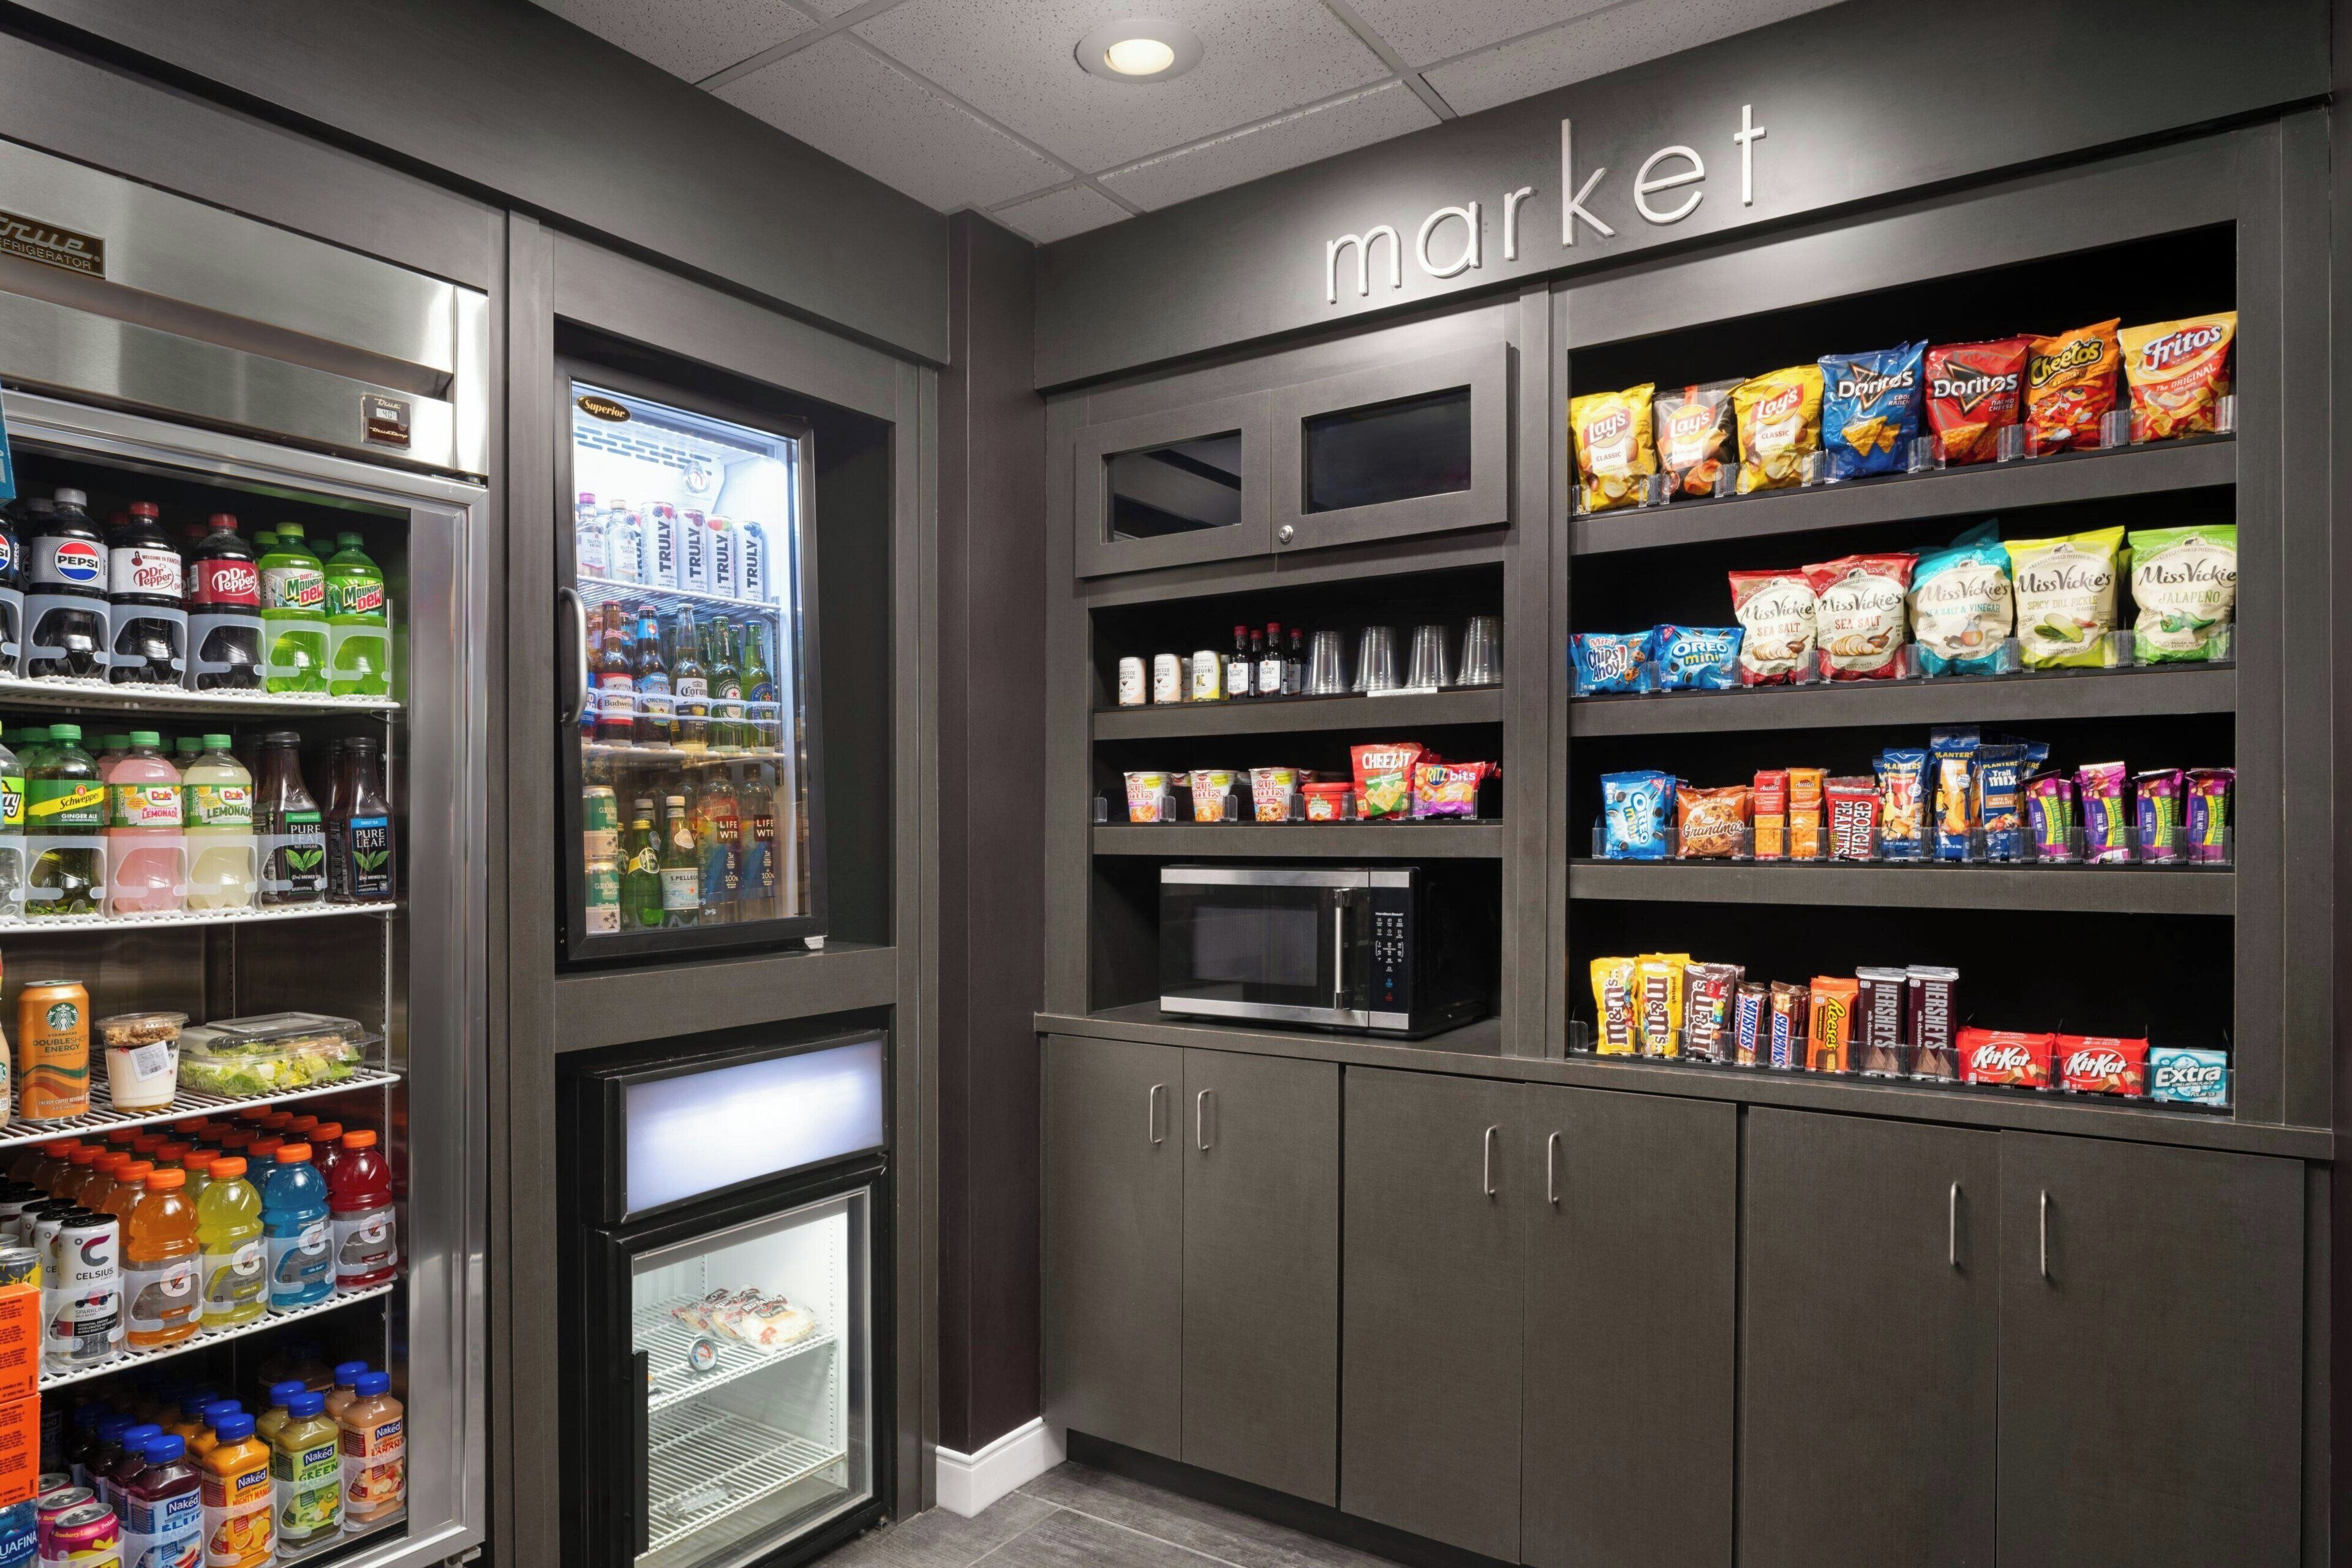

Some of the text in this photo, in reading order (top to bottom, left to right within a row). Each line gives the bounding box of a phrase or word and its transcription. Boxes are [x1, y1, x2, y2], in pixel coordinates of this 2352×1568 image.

[1326, 104, 1767, 304] market
[2143, 326, 2222, 371] Fritos
[2030, 341, 2103, 386] Cheetos
[1839, 371, 1913, 398] Doritos
[2171, 363, 2216, 388] ORIGINAL
[1934, 374, 2018, 397] Doritos
[584, 399, 625, 419] Superior
[1757, 388, 1798, 419] Lay's
[1589, 411, 1627, 441] Lay's
[1670, 411, 1710, 439] Lay's
[1762, 430, 1790, 440] CLASSIC
[1596, 452, 1621, 462] CLASSIC
[658, 521, 671, 573] TRULY
[688, 527, 701, 578] TRULY
[57, 555, 99, 569] PEPSI
[717, 534, 729, 583] TRULY
[746, 540, 758, 588] TRULY
[134, 568, 172, 587] Pepper
[149, 567, 164, 578] Dr
[213, 570, 255, 593] Pepper
[230, 567, 246, 580] Dr
[2019, 565, 2113, 594] Miss Vickie's
[2139, 565, 2184, 586] Miss
[1920, 576, 2008, 603] Miss Vickie's
[2158, 589, 2220, 605] JALAPEÑO
[1819, 588, 1902, 612] Miss Vickie's
[2028, 596, 2098, 609] SPICY DILL PICKLE
[1741, 606, 1774, 624] Miss
[1926, 608, 1939, 617] SEA
[1941, 606, 1959, 616] SALT
[1969, 603, 2000, 613] VINEGAR
[1757, 622, 1801, 637] SEA SALT
[1834, 615, 1881, 630] SEA SALT
[1589, 638, 1616, 647] Mini
[1672, 642, 1728, 655] OREO
[1587, 649, 1618, 669] Chips
[1685, 653, 1719, 666] mini
[1983, 761, 2018, 769] PLANTERS
[1427, 767, 1476, 782] RITZ bits
[1989, 775, 2017, 786] mix
[1195, 782, 1213, 791] CUP
[1257, 780, 1277, 789] CUP
[60, 792, 99, 810] Schweppes
[151, 791, 172, 800] Dole
[224, 791, 243, 800] Dole
[142, 810, 178, 820] LEMONADE
[207, 806, 252, 819] LEMONADE
[1630, 791, 1649, 844] OREO
[290, 824, 321, 834] PURE
[1623, 805, 1637, 840] mini
[1683, 820, 1745, 837] Grandma's
[1834, 800, 1853, 858] PEANUTS
[1850, 801, 1872, 855] GEORGIA
[356, 828, 385, 839] PURE
[720, 831, 738, 839] WTR
[756, 829, 774, 837] WTR
[356, 837, 385, 848] LEAF
[1604, 978, 1629, 1046] m&m's
[1645, 976, 1670, 1046] m&m's
[1688, 980, 1715, 1053] m&m's
[1874, 983, 1898, 1048] HERSHEY'S
[1924, 982, 1948, 1049] HERSHEY'S
[1740, 997, 1758, 1049] SATISFIES
[1826, 997, 1846, 1050] Reese's
[32, 1035, 88, 1046] DOUBLESHOT
[45, 1043, 80, 1053] ENERGY
[1773, 1012, 1789, 1066] SNICKERS
[2155, 1066, 2221, 1088] Extra
[76, 1267, 114, 1280] CELSIUS
[75, 1305, 107, 1315] SPARKLING
[743, 1303, 757, 1311] RED
[377, 1422, 400, 1439] Naked
[306, 1447, 333, 1464] Naked
[238, 1469, 266, 1489] Naked
[299, 1462, 337, 1481] GREEN
[169, 1494, 198, 1513] Naked
[80, 1527, 99, 1536] Lemon
